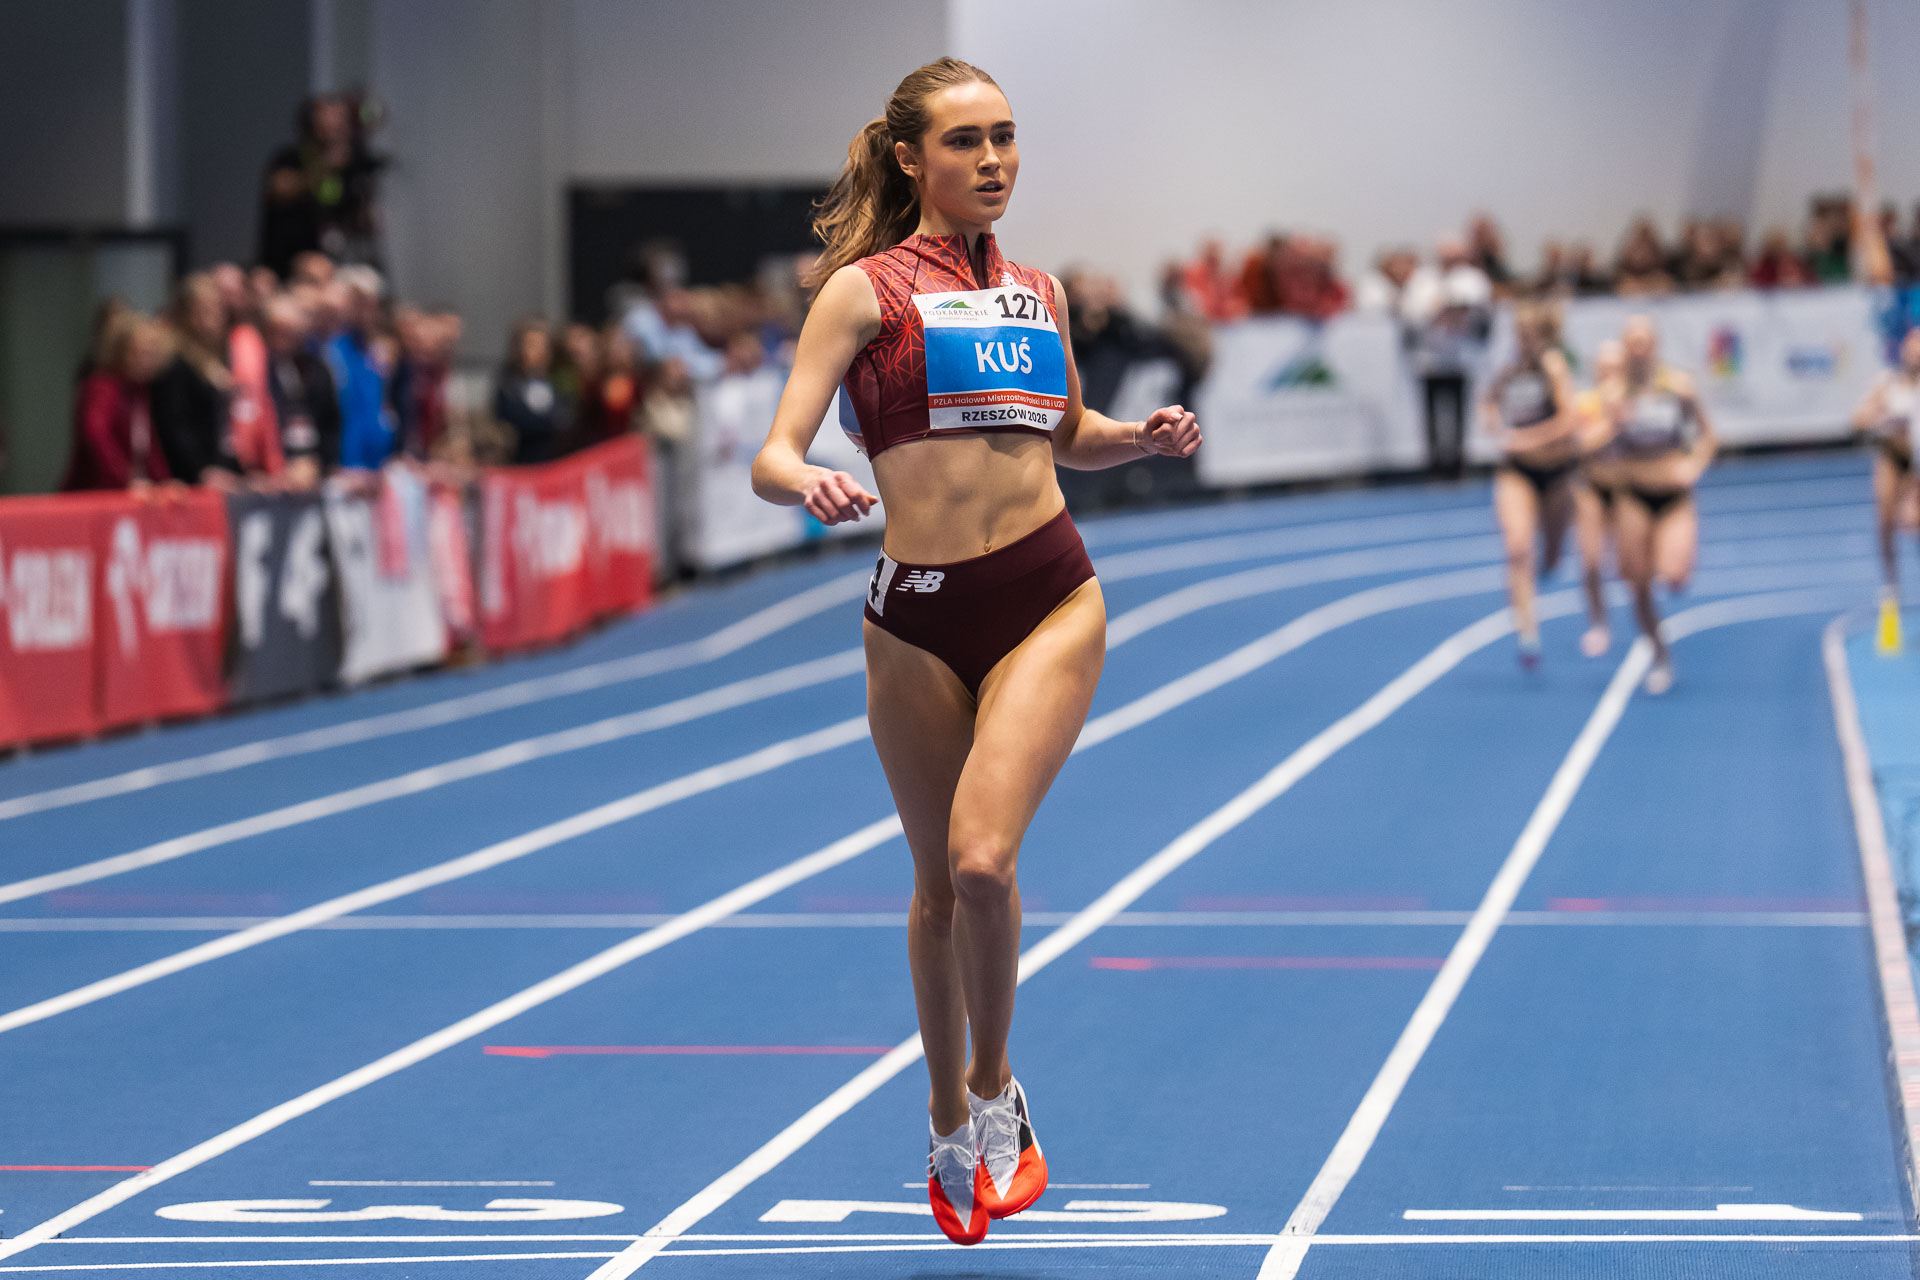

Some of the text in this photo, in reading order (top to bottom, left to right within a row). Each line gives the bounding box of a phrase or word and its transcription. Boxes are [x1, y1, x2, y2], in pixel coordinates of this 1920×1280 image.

[923, 309, 989, 317] PODKARPACKIE
[974, 336, 1033, 375] KUŚ
[933, 398, 953, 406] PZLA
[954, 396, 986, 405] Halowe
[1040, 398, 1051, 407] U18
[1053, 400, 1065, 409] U20
[961, 405, 1048, 425] RZESZÓW 2026
